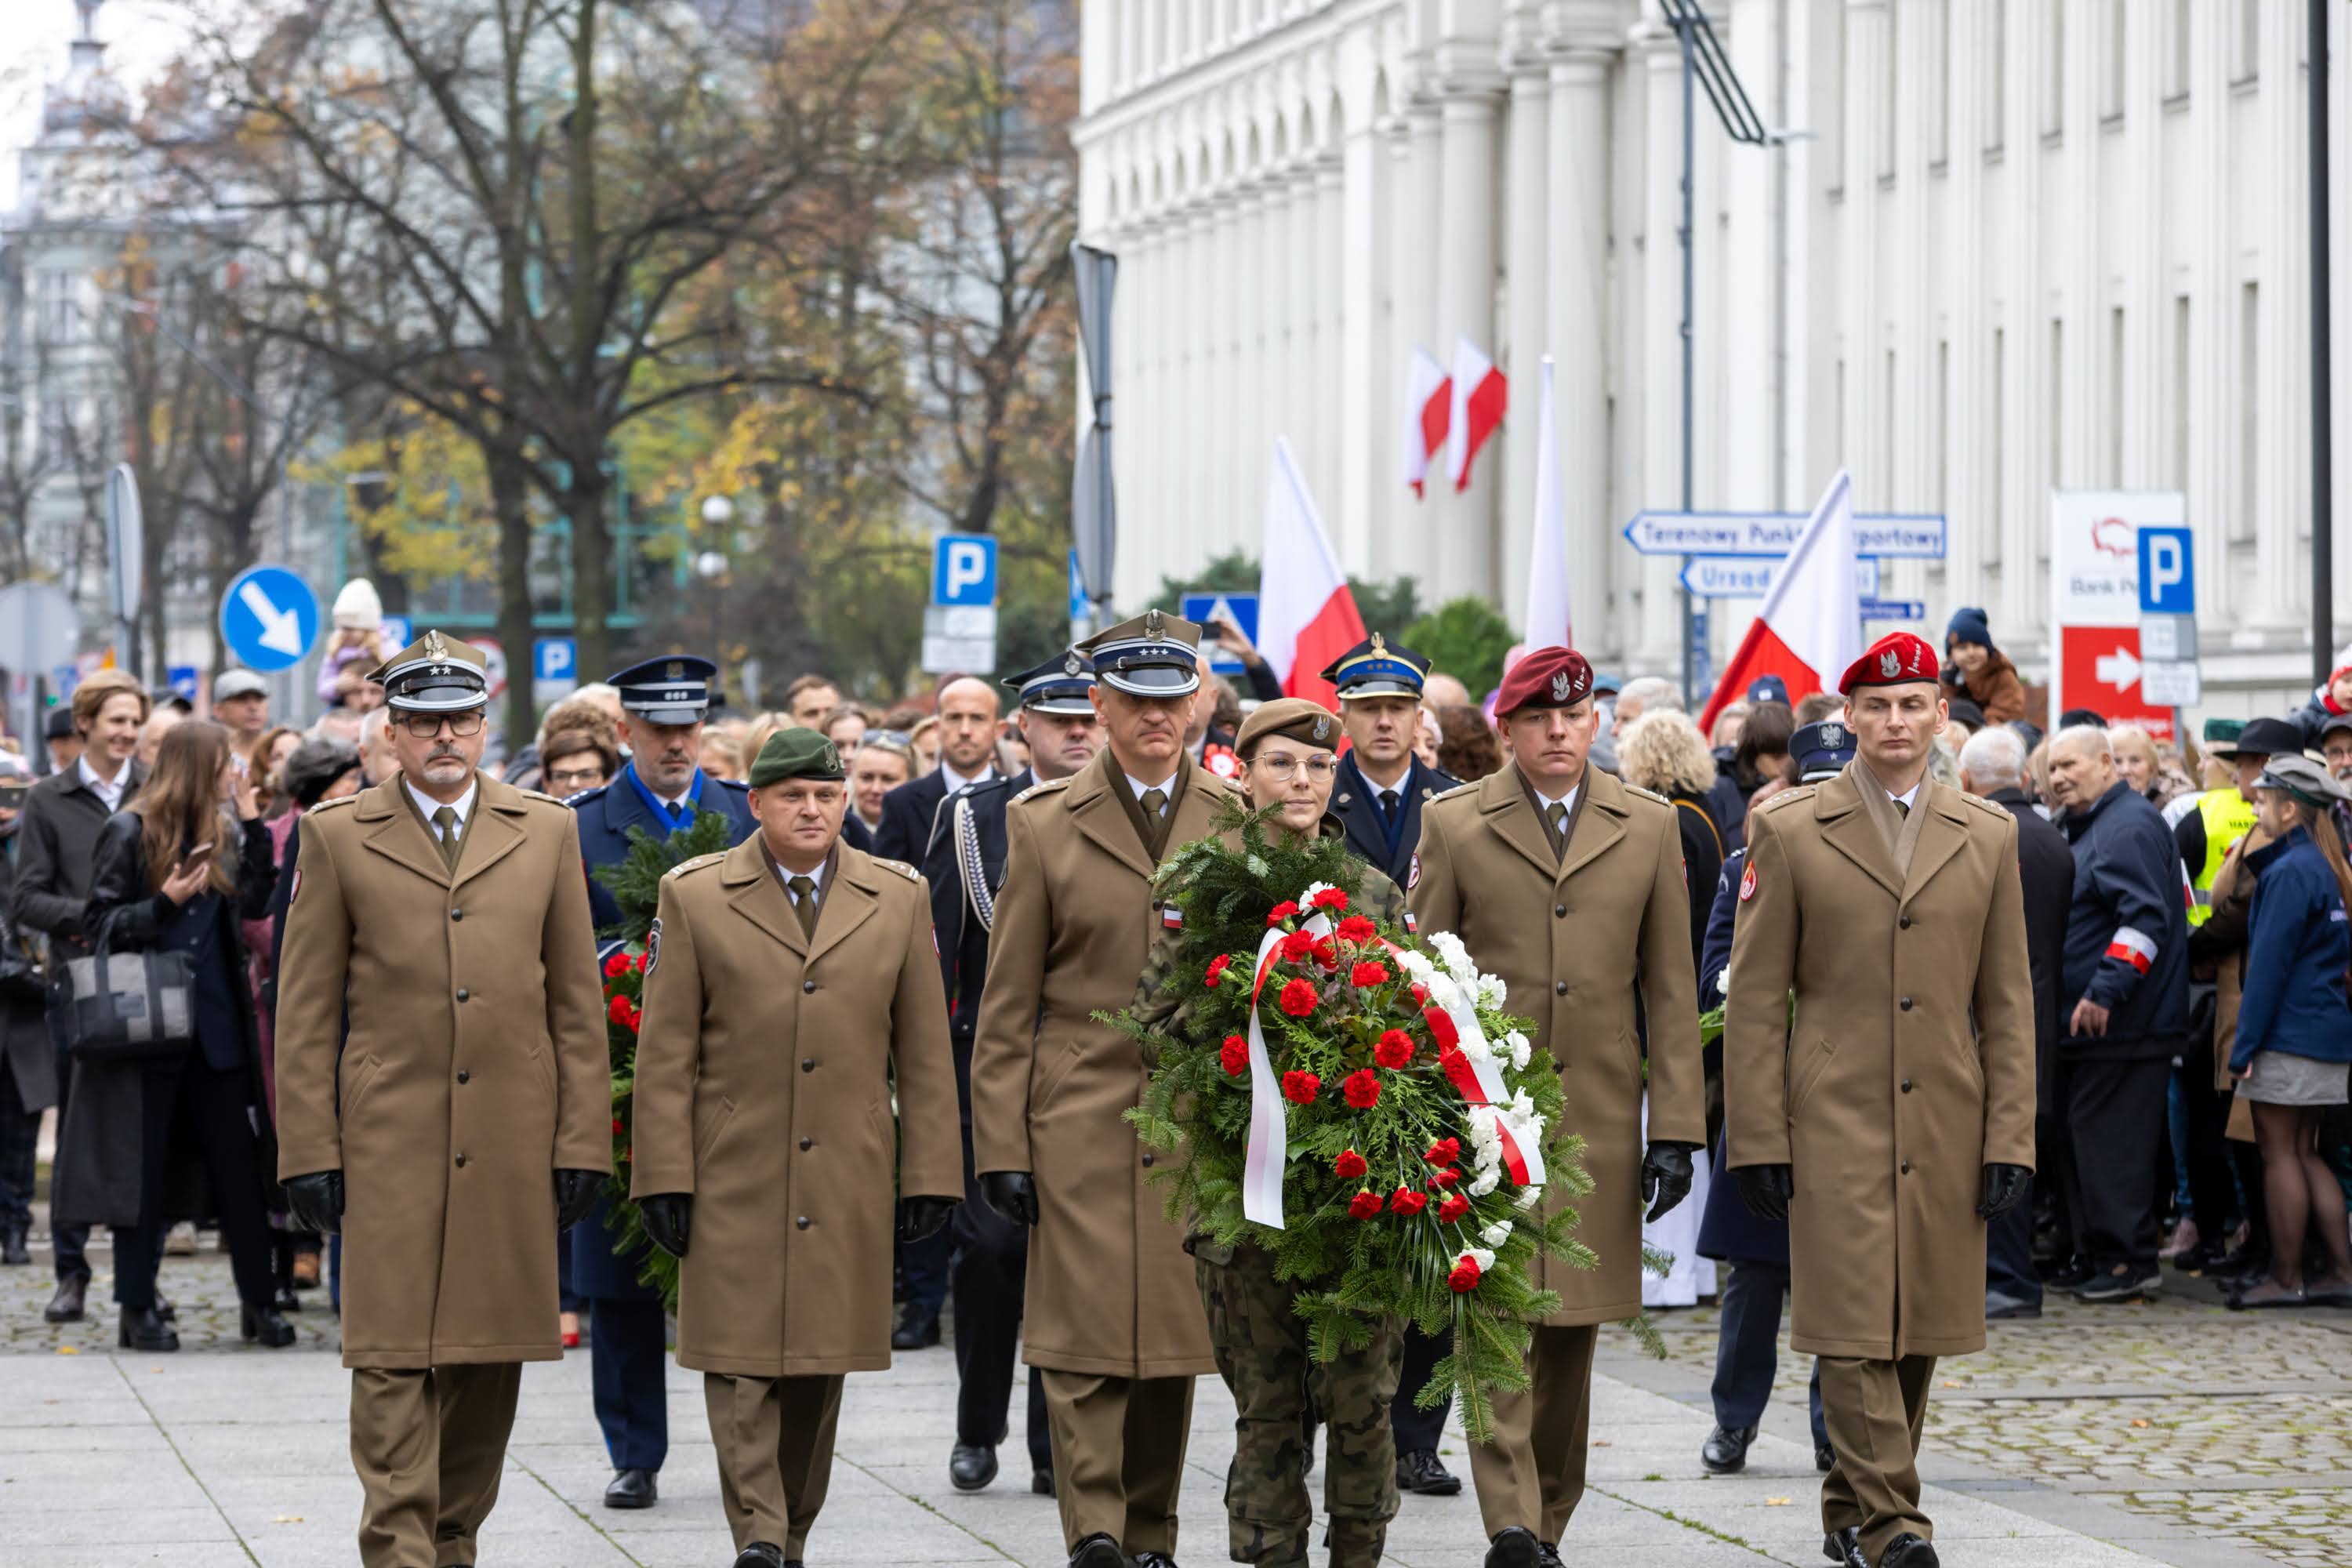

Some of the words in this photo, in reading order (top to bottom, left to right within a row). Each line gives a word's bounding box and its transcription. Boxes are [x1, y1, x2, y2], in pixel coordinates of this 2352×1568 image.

[1644, 522, 1738, 550] Terenowy
[946, 541, 986, 599] P
[2071, 578, 2116, 596] Bank
[2149, 535, 2182, 604] P
[543, 642, 571, 678] P
